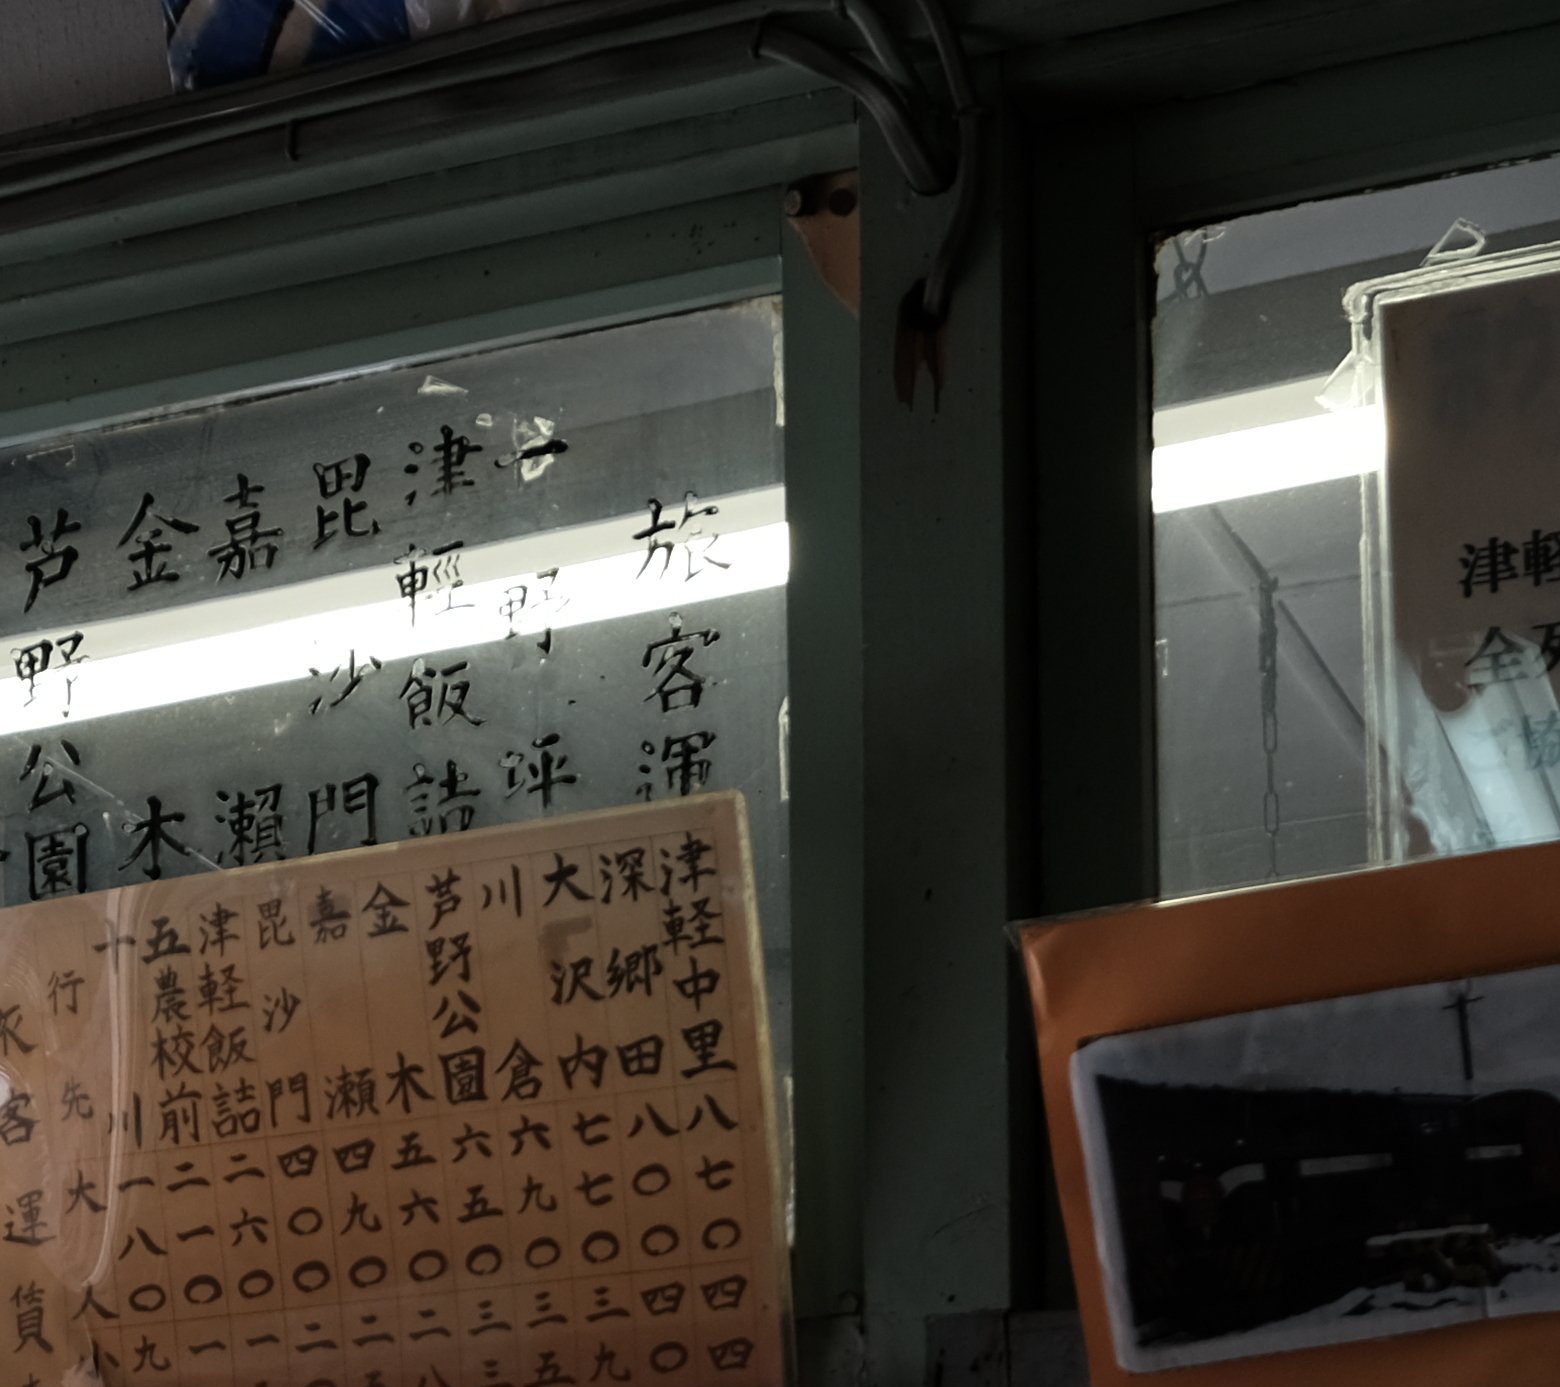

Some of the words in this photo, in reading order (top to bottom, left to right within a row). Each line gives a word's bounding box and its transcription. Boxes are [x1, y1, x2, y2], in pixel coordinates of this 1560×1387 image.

[11, 507, 89, 900] 芦野公園
[117, 492, 201, 881] 金木
[198, 901, 265, 1138] 津軽飯詰
[257, 890, 314, 1127] 毘沙門
[361, 882, 435, 1113] 金木
[424, 865, 490, 1107] 芦野公園
[541, 853, 610, 1090] 大沢内
[656, 828, 737, 1081] 津軽中里
